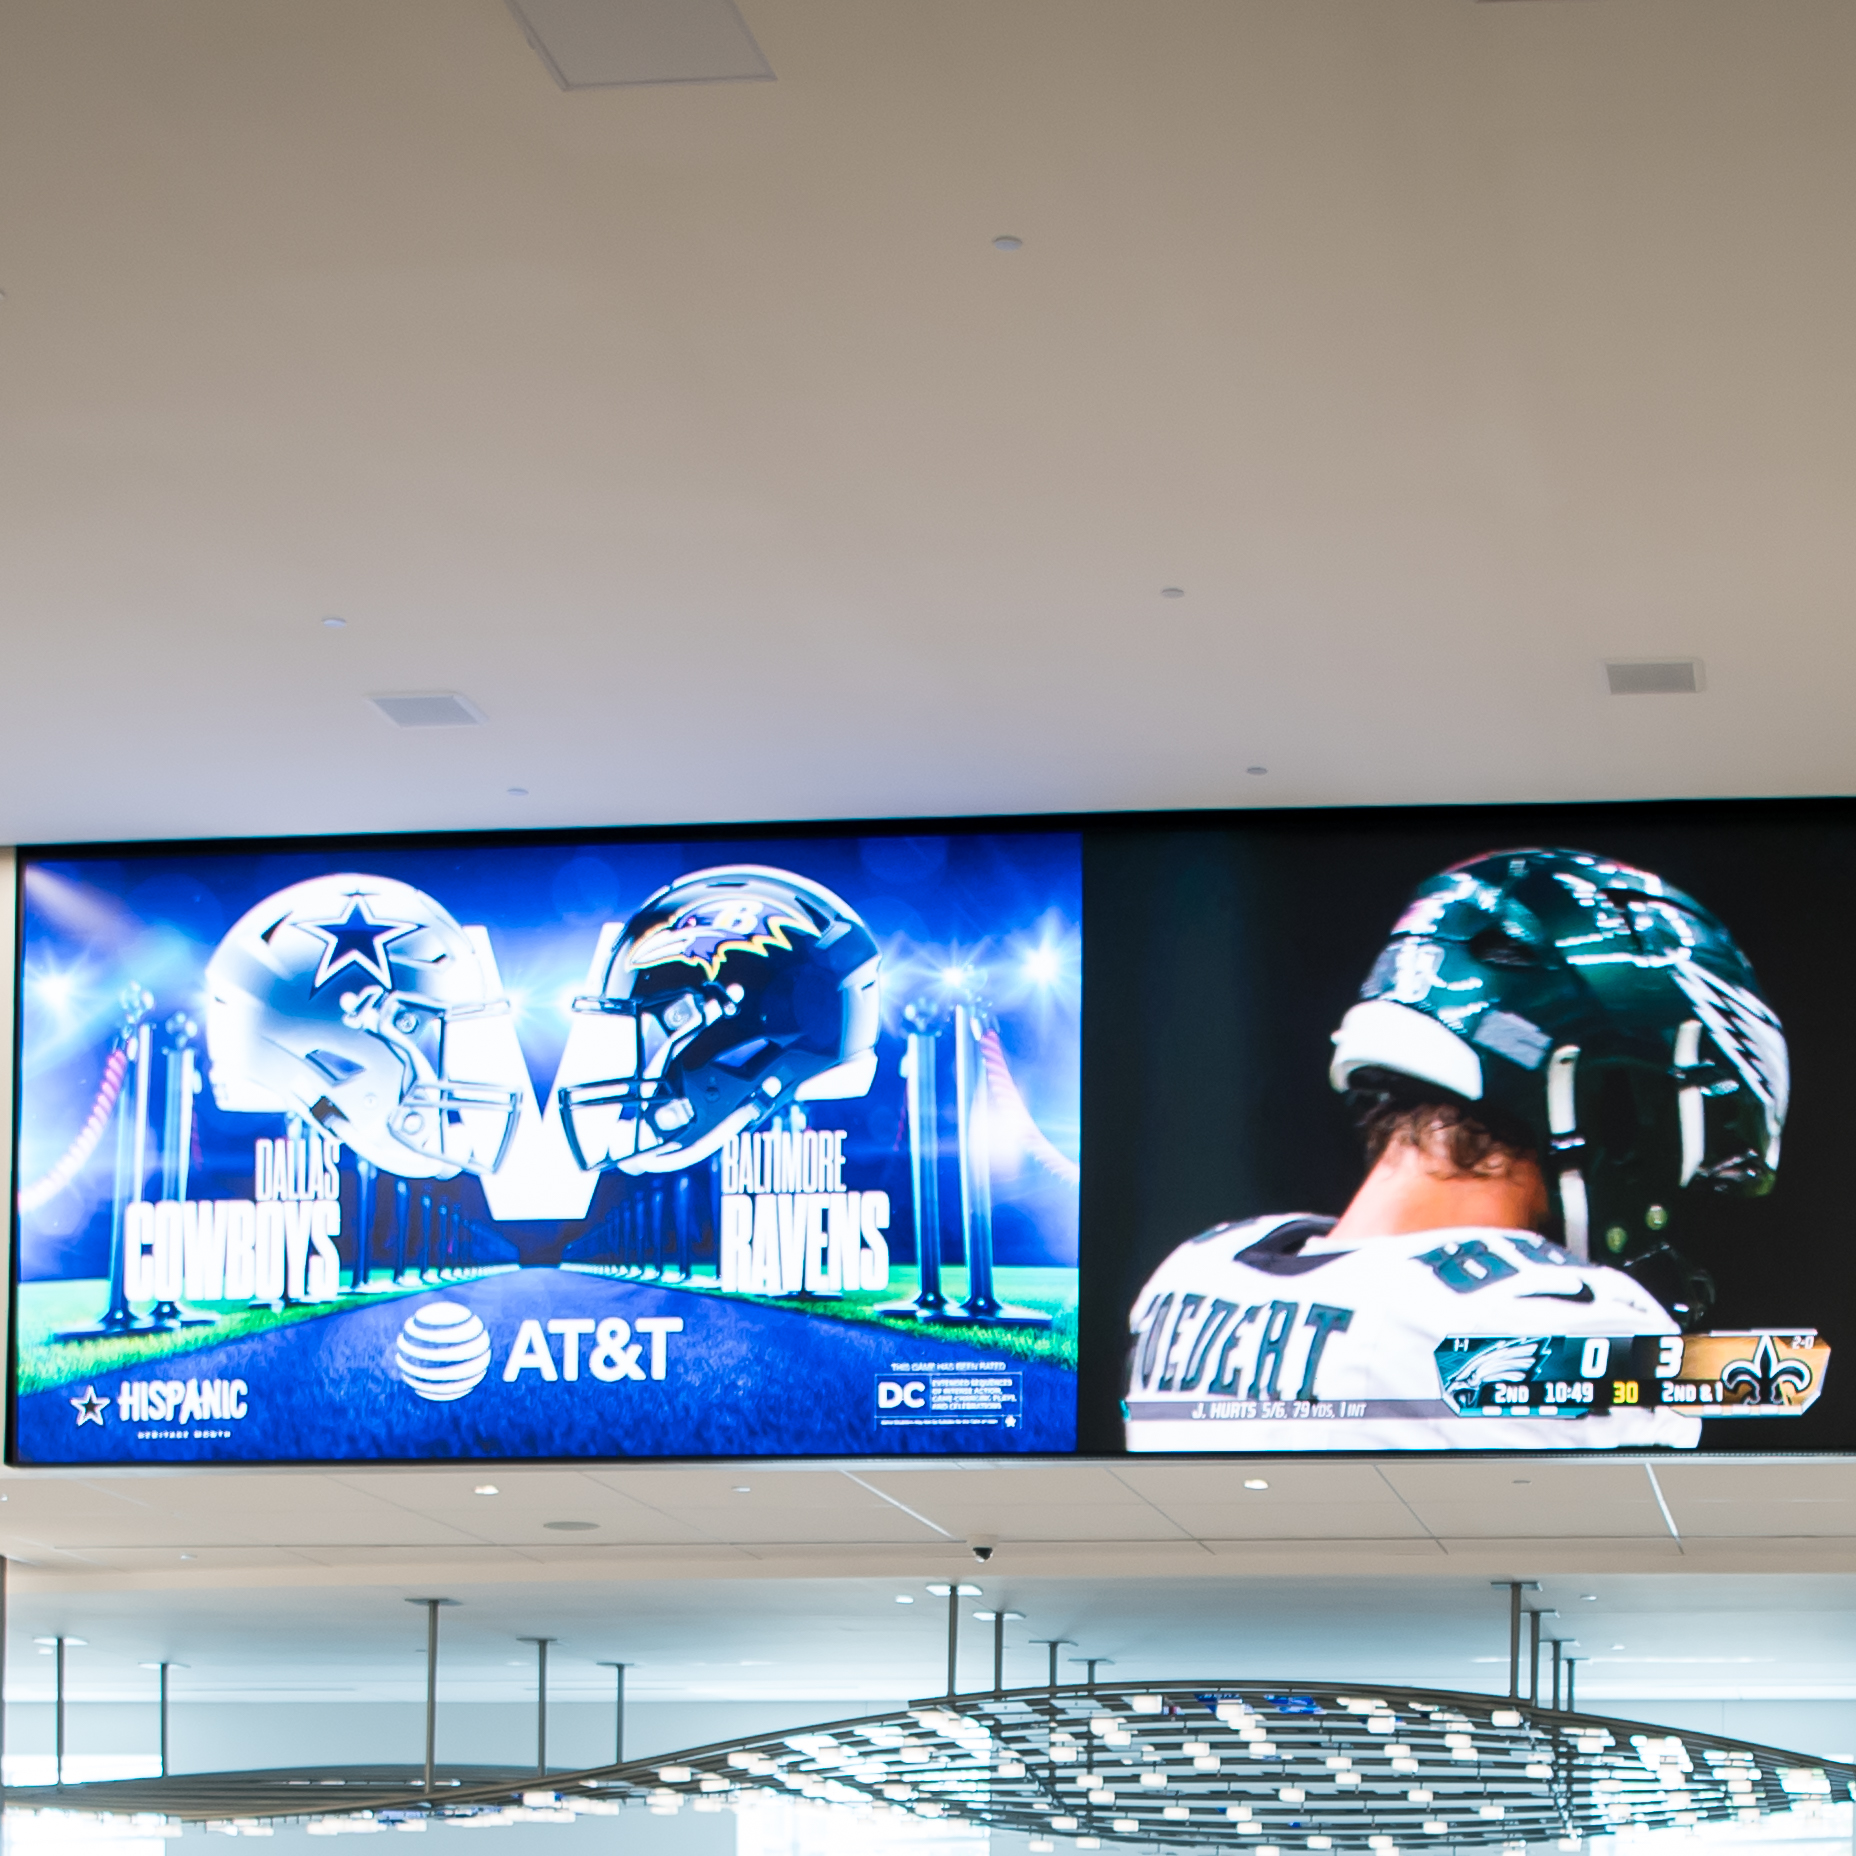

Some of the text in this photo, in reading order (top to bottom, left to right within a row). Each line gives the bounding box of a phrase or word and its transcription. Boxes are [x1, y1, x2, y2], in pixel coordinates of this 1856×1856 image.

[255, 1138, 340, 1200] DALLAS
[721, 1130, 847, 1194] BALTIMORE
[123, 1200, 341, 1301] COWBOYS
[721, 1191, 890, 1292] RAVENS
[502, 1317, 684, 1382] AT&T
[1580, 1338, 1610, 1378] 0
[1655, 1337, 1684, 1378] 3
[117, 1378, 249, 1425] HISPANIC
[878, 1381, 925, 1409] DC
[1192, 1402, 1206, 1419] J.
[1210, 1402, 1256, 1419] HURTS
[1292, 1402, 1309, 1419] 79
[1494, 1382, 1594, 1403] 2ND 10:49
[1613, 1381, 1639, 1403] 30
[1661, 1382, 1697, 1403] 2ND
[1700, 1382, 1713, 1403] &
